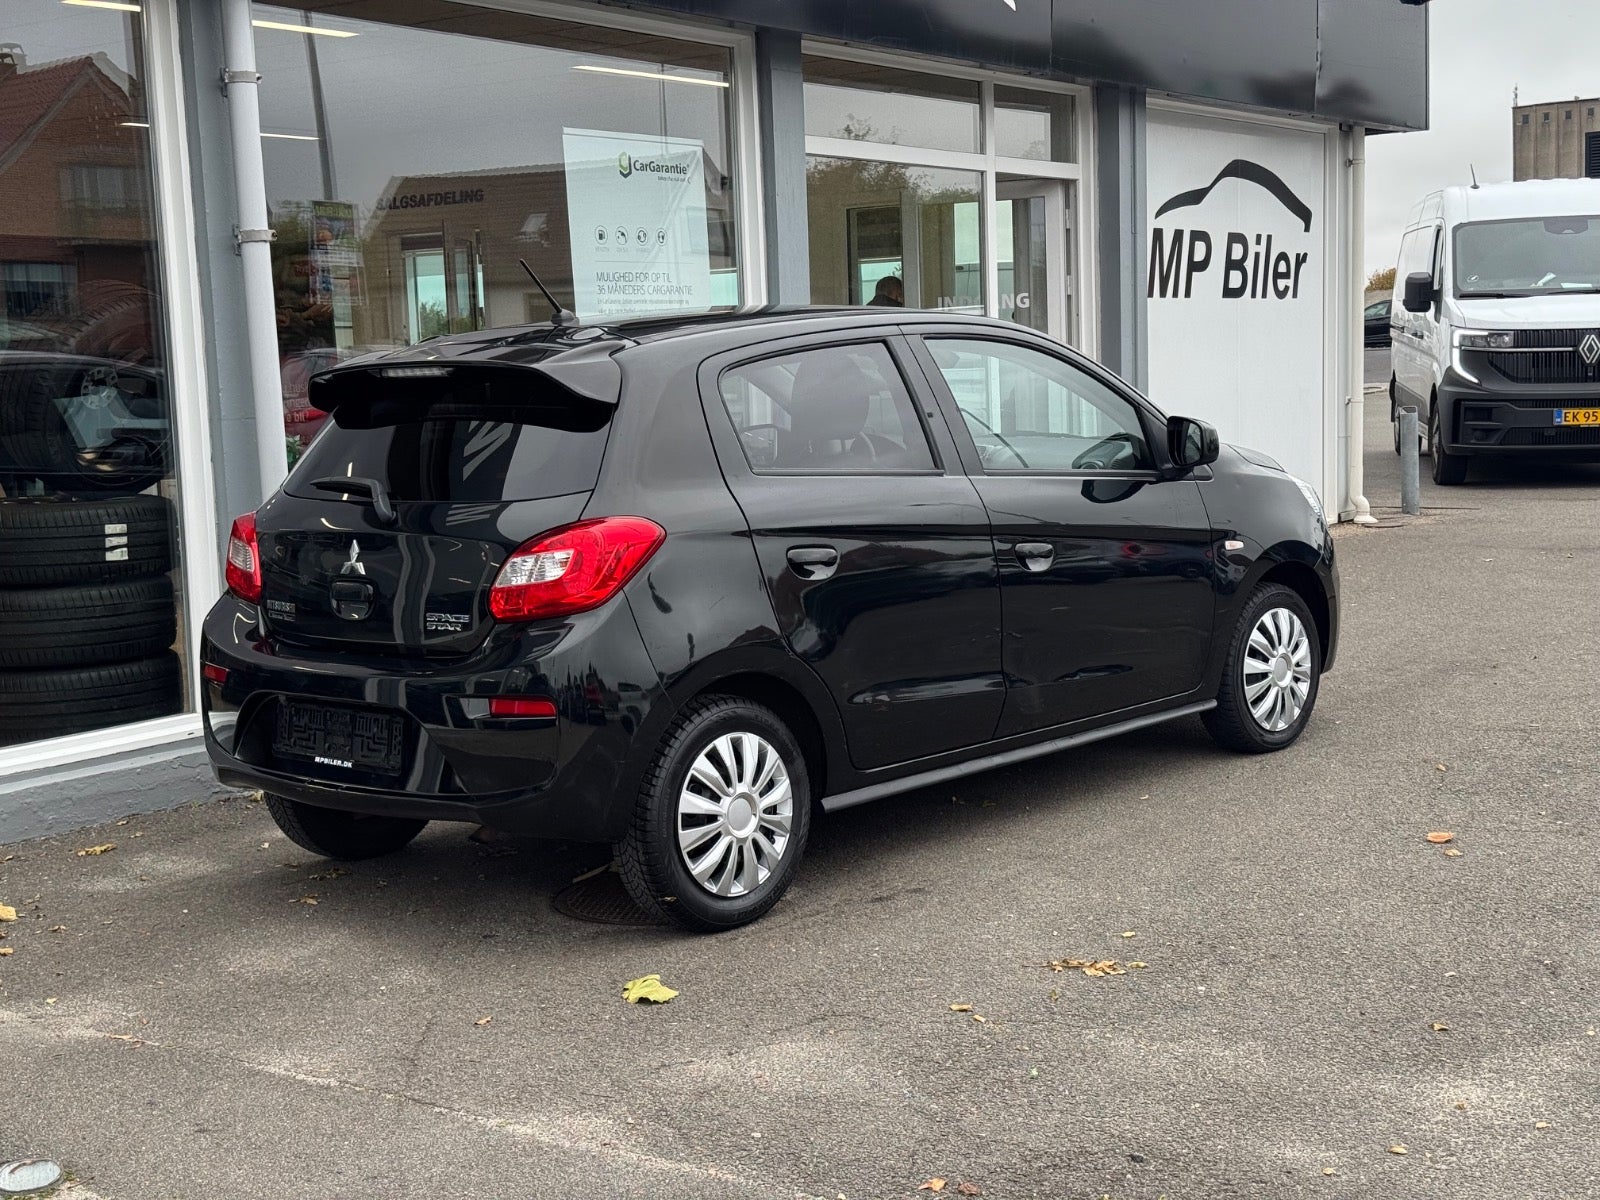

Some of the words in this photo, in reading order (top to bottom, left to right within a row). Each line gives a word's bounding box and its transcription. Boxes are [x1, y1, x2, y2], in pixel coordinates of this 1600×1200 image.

[1147, 228, 1212, 298] MP
[1222, 232, 1308, 299] Biler
[596, 271, 633, 282] MULIGHED
[635, 272, 649, 282] FOR
[651, 272, 661, 283] OP
[662, 273, 672, 283] TIL
[597, 284, 606, 295] 36
[607, 283, 645, 295] MÅNEDERS
[647, 285, 693, 295] CARGARANTIE
[1564, 411, 1580, 423] EK
[1583, 411, 1599, 423] 95
[426, 612, 470, 623] SPACE
[426, 622, 462, 631] STAR
